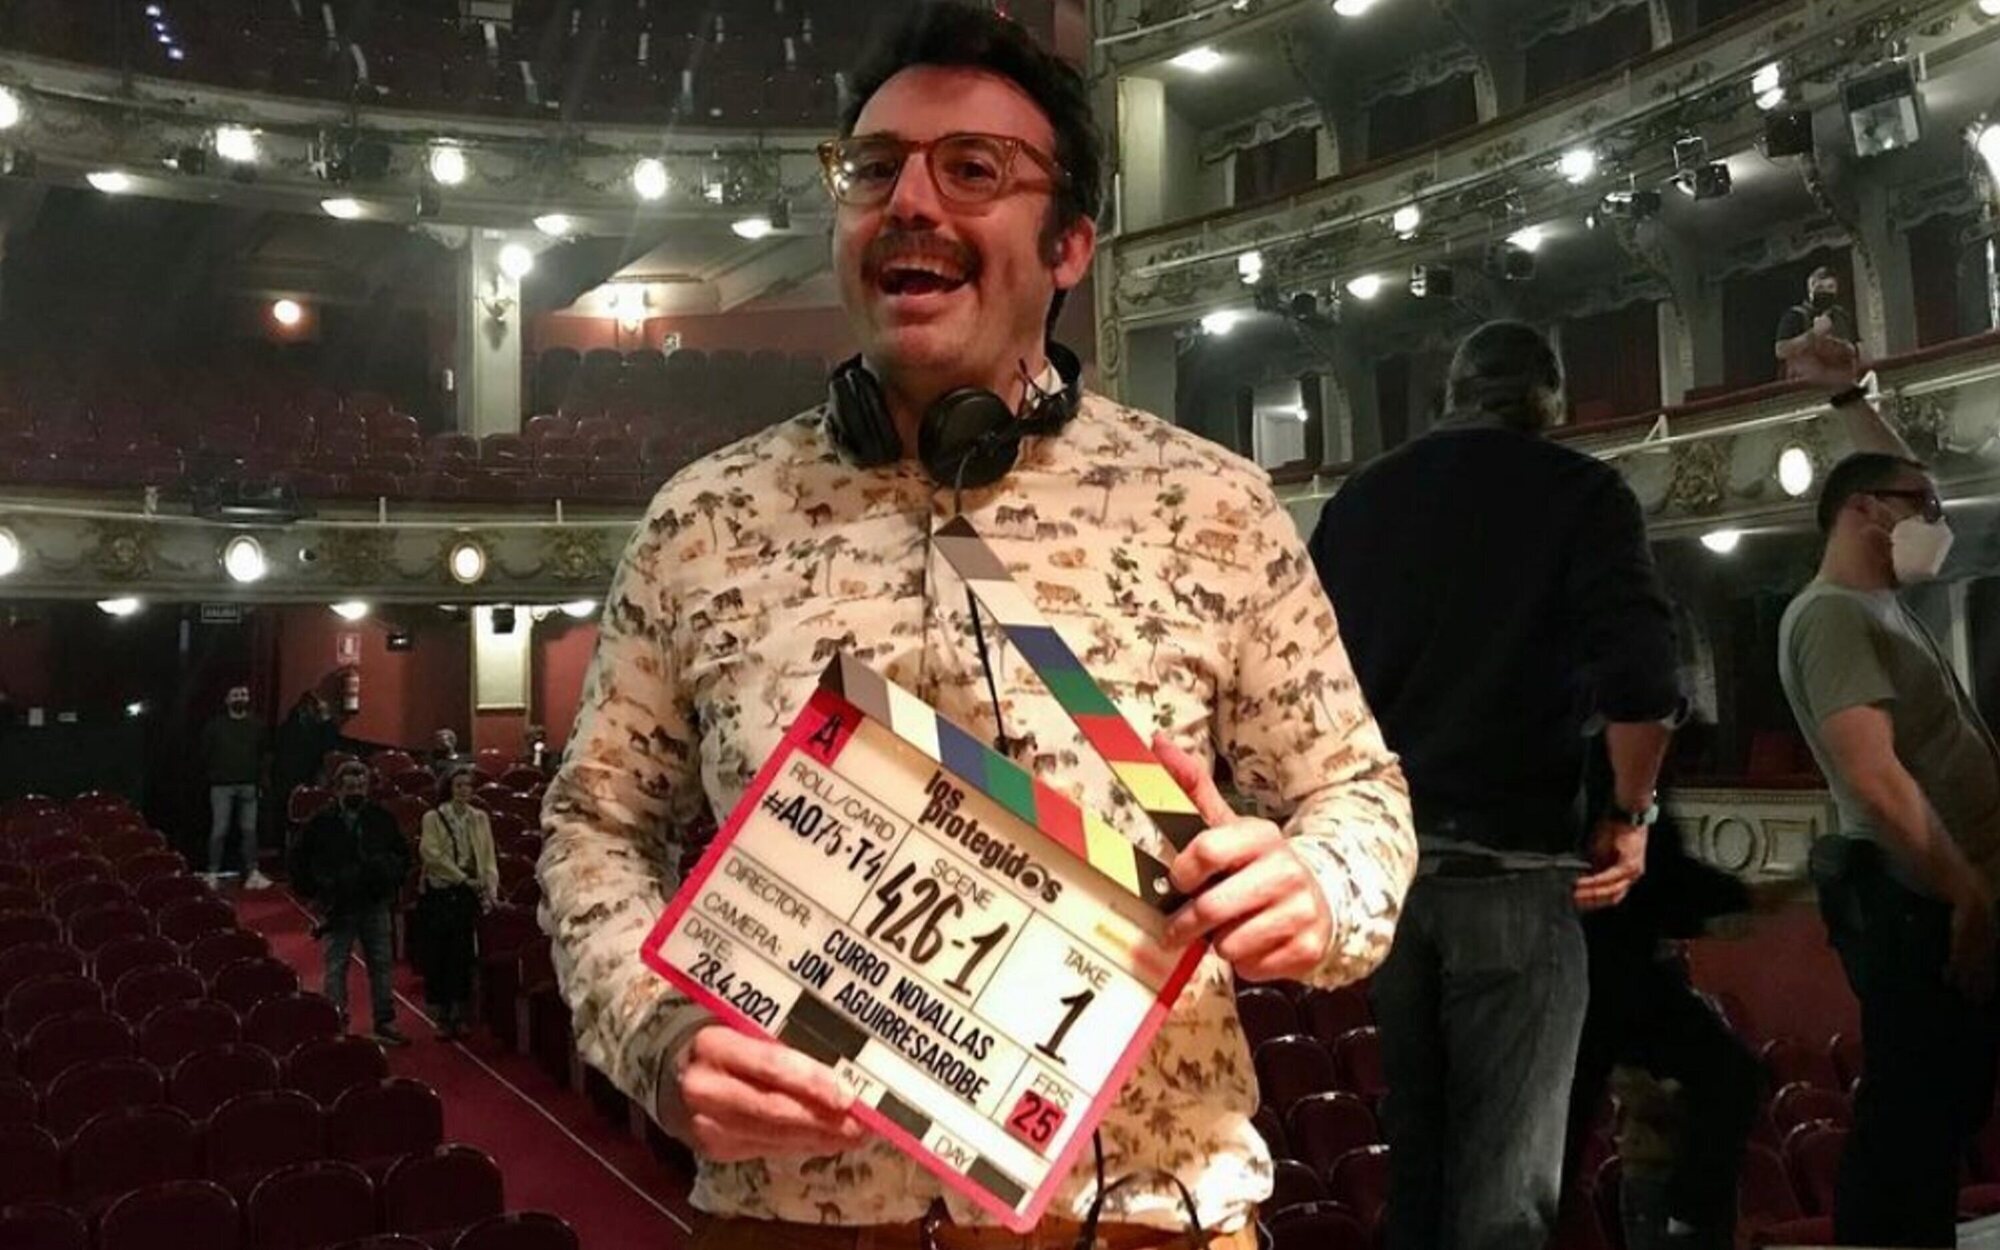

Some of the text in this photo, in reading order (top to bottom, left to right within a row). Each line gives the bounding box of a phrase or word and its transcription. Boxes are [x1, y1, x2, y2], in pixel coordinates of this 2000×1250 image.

[810, 713, 842, 757] A
[789, 760, 896, 842] ROLL/CARD
[924, 770, 965, 810] los
[918, 796, 1063, 904] protegidos
[724, 856, 812, 929] DIRECTOR:
[931, 858, 995, 911] SCENE
[703, 891, 783, 957] CAMERA:
[865, 861, 1010, 997] 426-1
[823, 929, 995, 1061] CURRO NOVALLAS
[1063, 946, 1112, 990] TAKE
[788, 949, 990, 1105] JON AGUIRRESAROBE
[1034, 988, 1096, 1066] 1
[1013, 1089, 1060, 1144] 25
[1032, 1071, 1074, 1109] FPS
[934, 1135, 975, 1168] DAY
